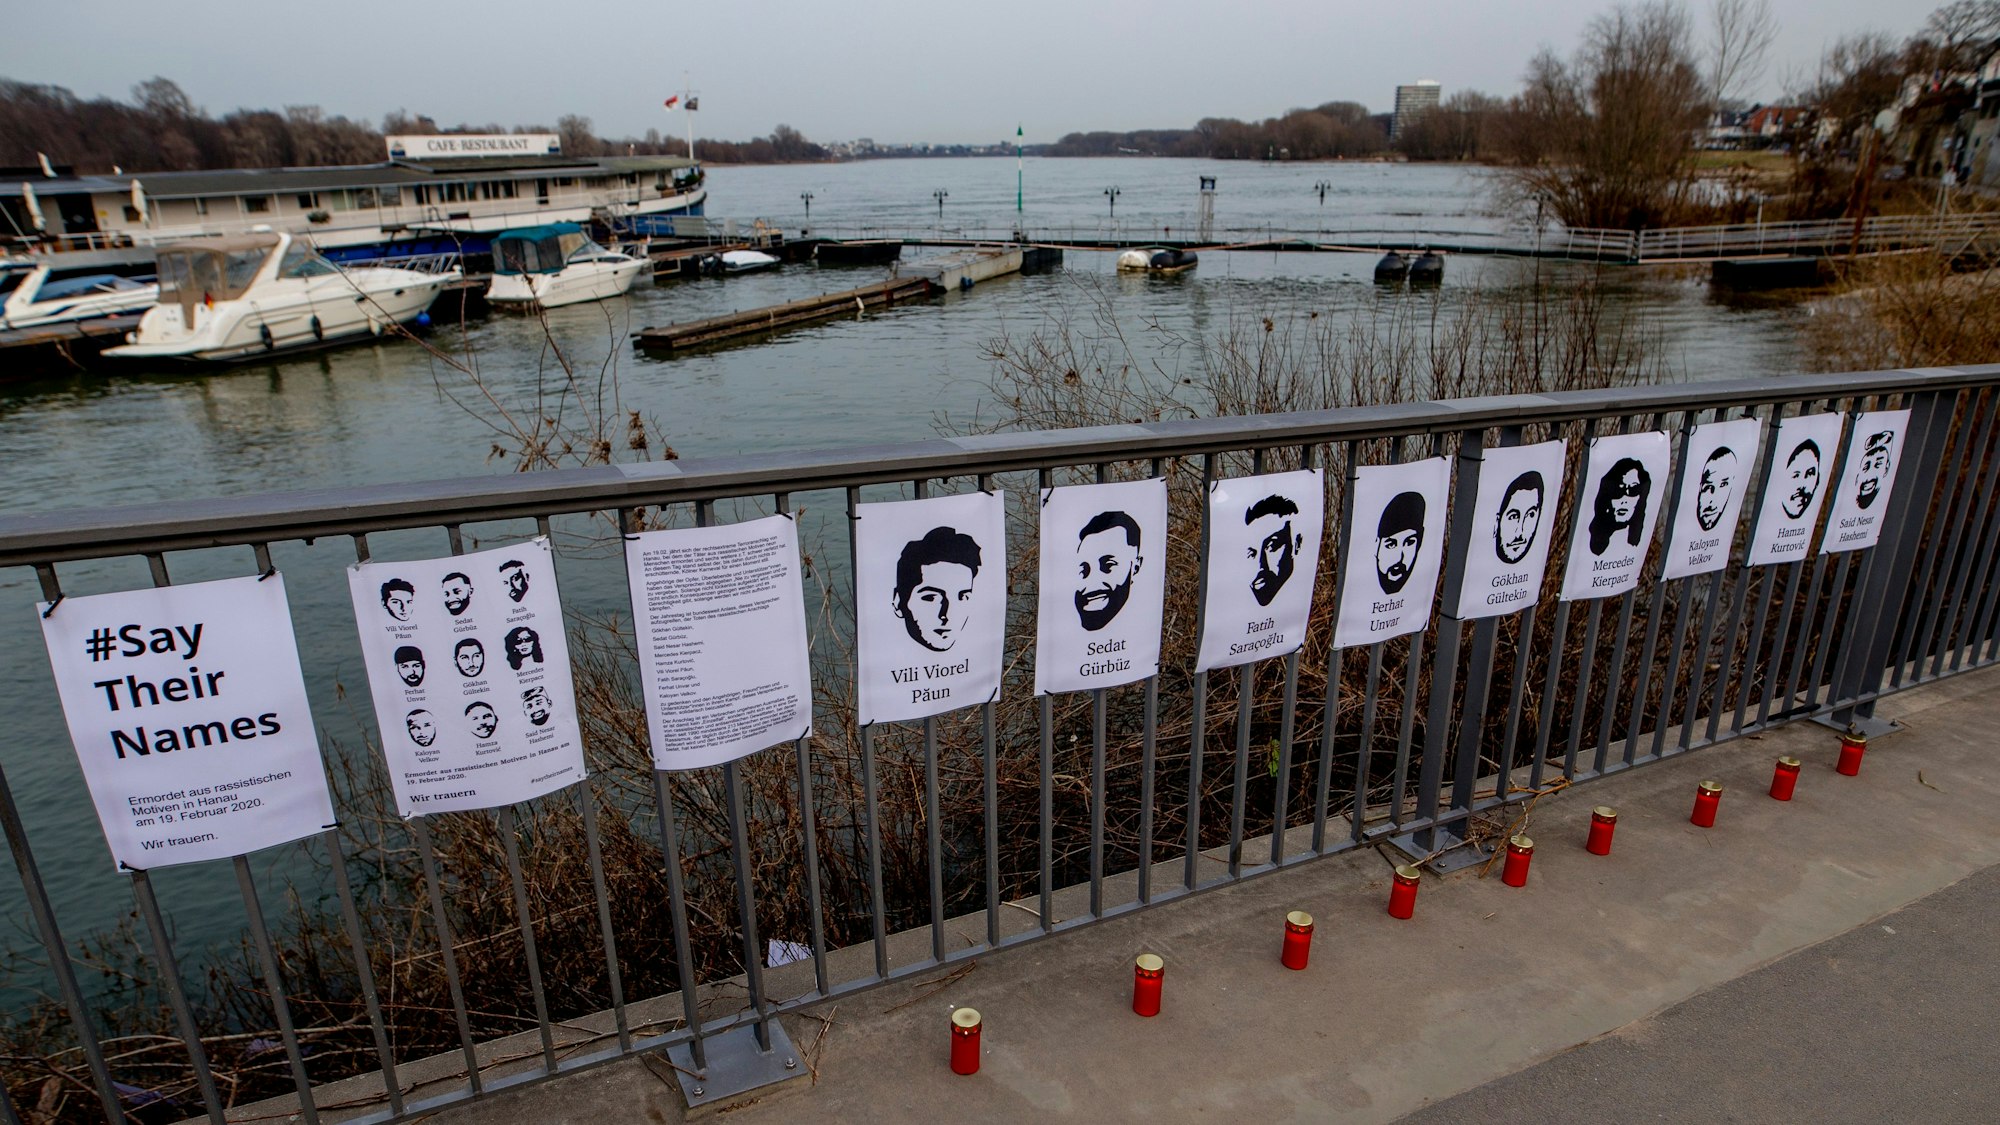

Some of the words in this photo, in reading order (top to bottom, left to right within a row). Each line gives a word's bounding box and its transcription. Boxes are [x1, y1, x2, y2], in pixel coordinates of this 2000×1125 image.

[1839, 517, 1854, 529] Said
[1856, 515, 1875, 527] Nesar
[1777, 525, 1806, 539] Hamza
[1839, 528, 1868, 543] Hashemi
[1688, 537, 1719, 553] Kaloyan
[1770, 538, 1806, 554] Kurtović
[1593, 555, 1635, 572] Mercedes
[1688, 552, 1713, 566] Velkov
[1491, 570, 1529, 588] Gökhan
[1591, 572, 1630, 589] Kierpacz
[1487, 587, 1528, 606] Gültekin
[512, 606, 527, 614] Fatih
[1372, 598, 1404, 615] Ferhat
[454, 617, 473, 625] Sedat
[1246, 617, 1274, 635] Fatih
[1370, 615, 1400, 632] Unvar
[86, 623, 203, 662] #Say
[1087, 638, 1127, 655] Sedat
[1229, 633, 1284, 657] Saraçoğlu
[516, 667, 544, 677] Mercedes
[891, 668, 921, 685] Vili
[925, 659, 969, 680] Viorel
[1079, 657, 1131, 678] Gürbüz
[94, 667, 225, 711] Their
[463, 679, 488, 688] Gökhan
[911, 685, 951, 704] Păun
[110, 712, 281, 759] Names
[476, 740, 498, 748] Hamza
[404, 769, 437, 778] Ermordet
[454, 760, 498, 773] rassistischen
[500, 754, 527, 765] Motiven
[538, 746, 558, 756] Hanau
[128, 790, 185, 806] Ermordet
[189, 786, 212, 797] aus
[215, 770, 292, 792] rassistischen
[418, 775, 445, 784] Februar
[132, 801, 180, 816] Motiven
[184, 798, 193, 808] in
[198, 792, 238, 807] Hanau
[410, 794, 431, 803] Wir
[434, 788, 476, 801] trauern
[136, 816, 155, 827] am
[159, 811, 177, 824] 19.
[180, 805, 228, 821] Februar
[232, 797, 265, 813] 2020.
[141, 837, 164, 851] Wir
[167, 831, 218, 847] trauern.
